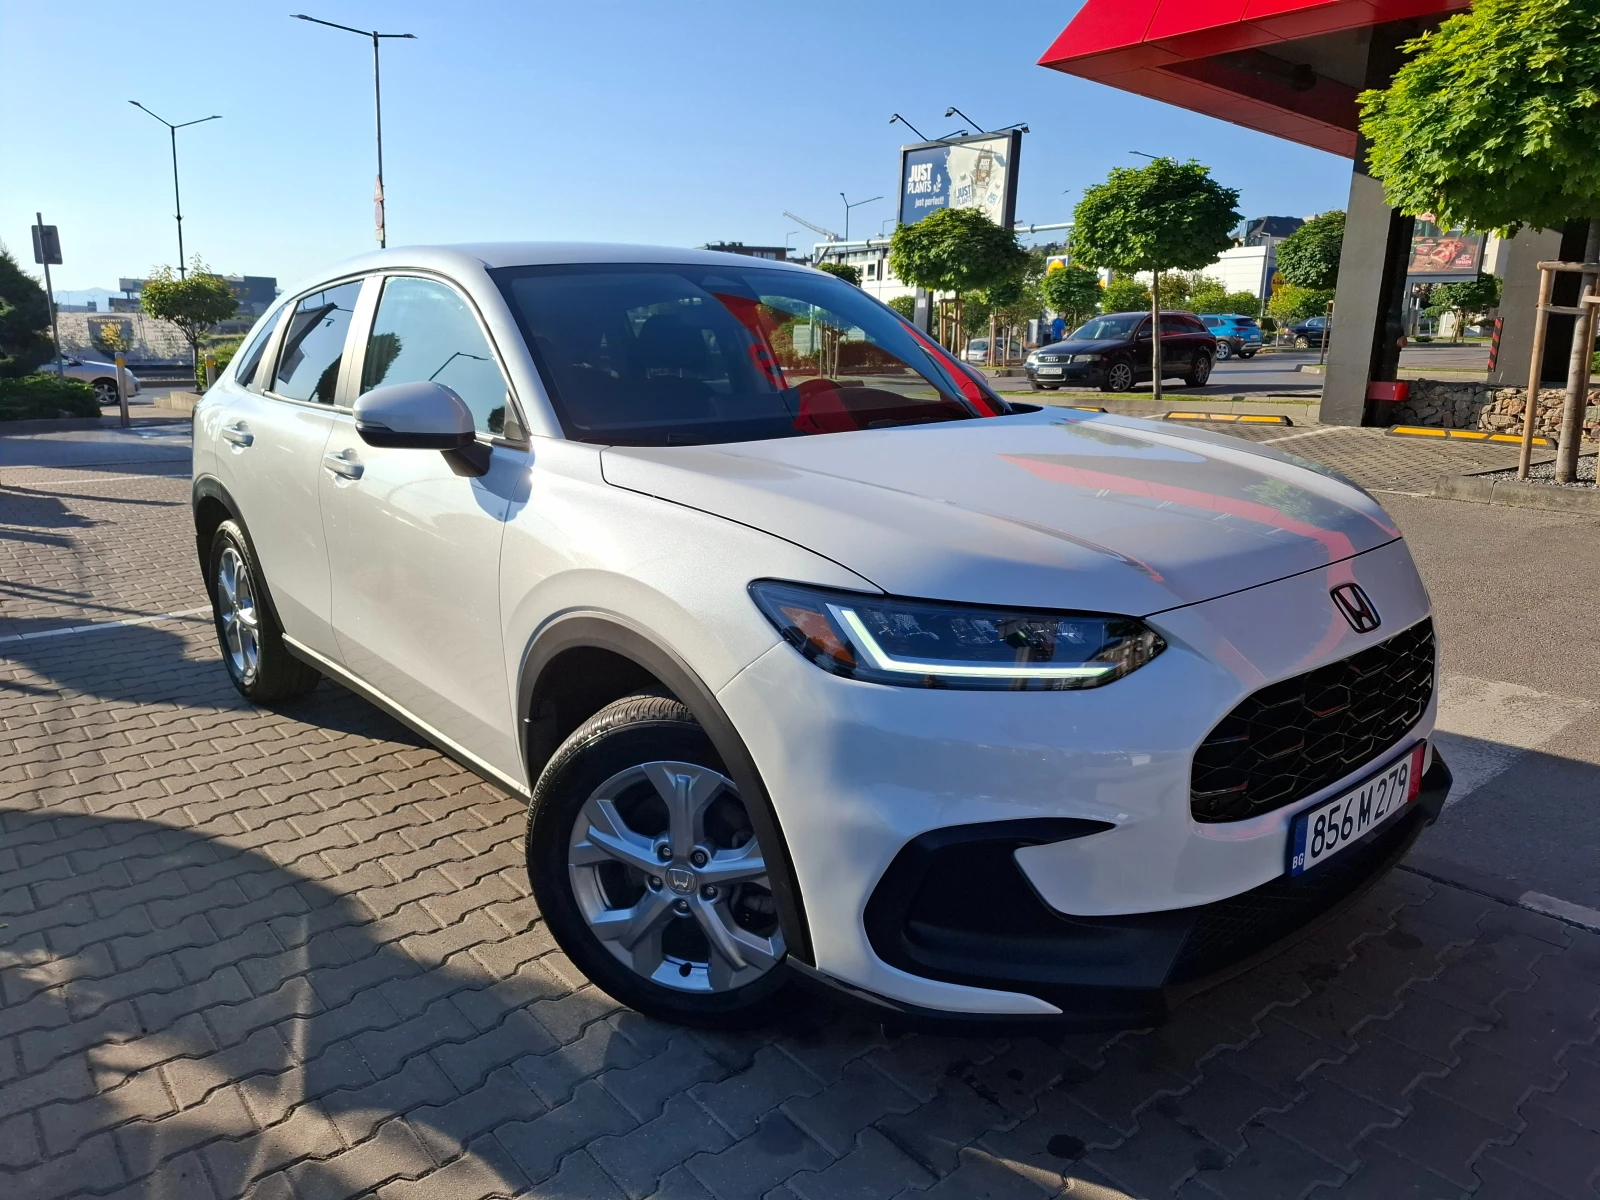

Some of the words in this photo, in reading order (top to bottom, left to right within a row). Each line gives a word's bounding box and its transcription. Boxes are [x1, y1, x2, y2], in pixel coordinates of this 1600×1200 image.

[908, 163, 932, 182] JUST
[907, 181, 931, 194] PLANTS
[957, 185, 971, 198] JUST
[914, 198, 924, 208] just
[957, 196, 971, 206] PLANTS
[1292, 852, 1304, 869] BG
